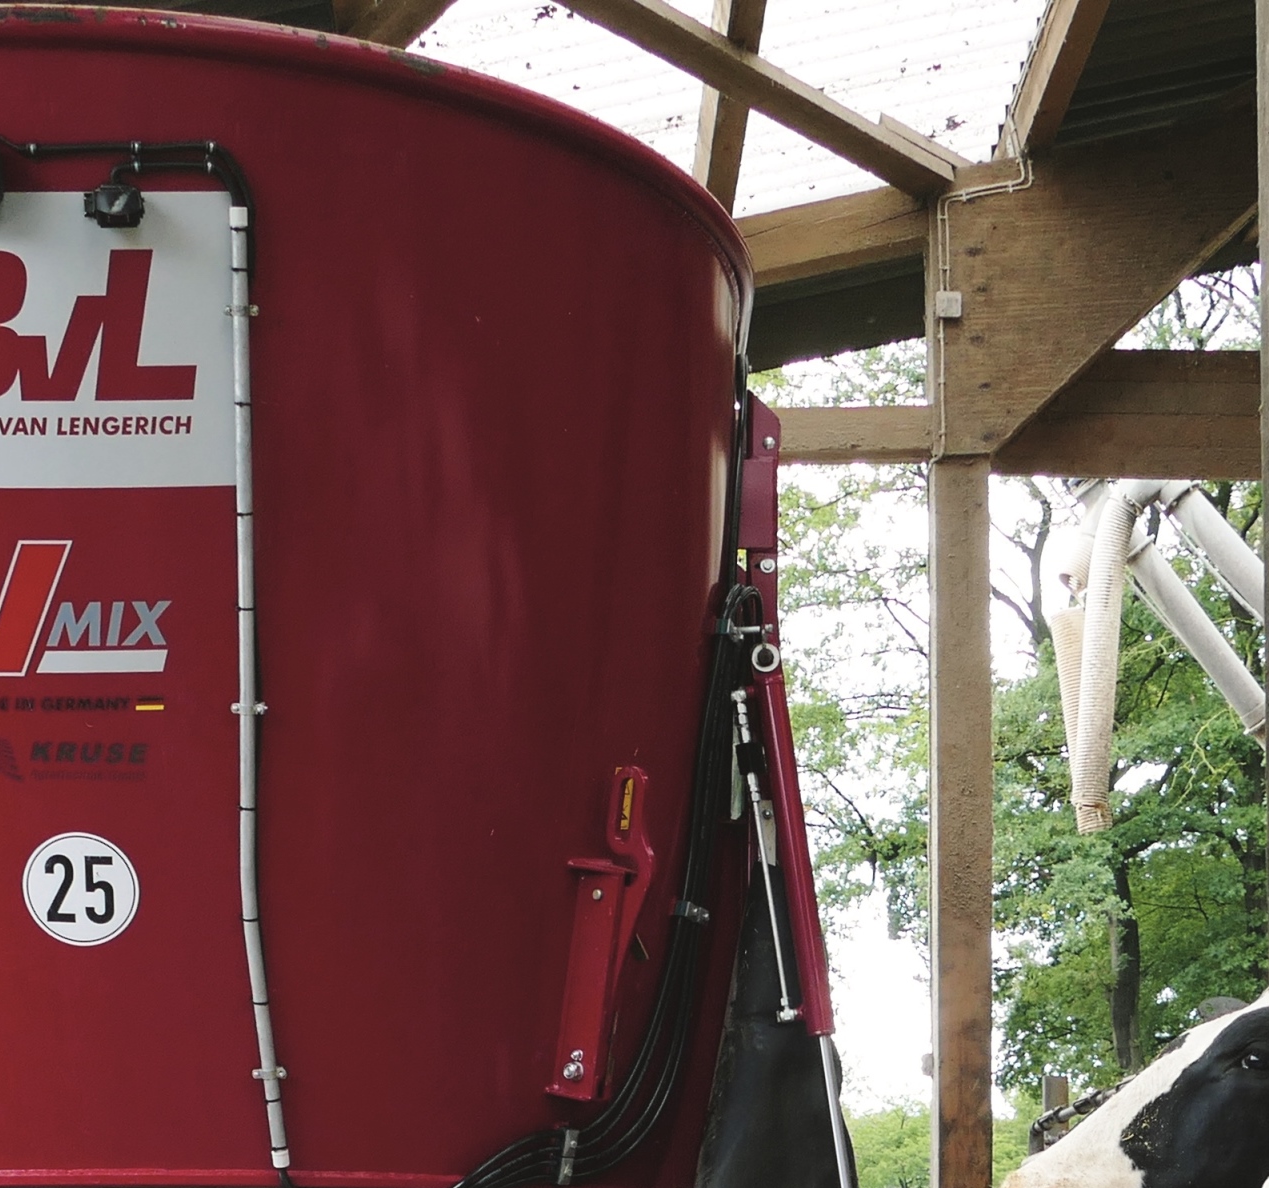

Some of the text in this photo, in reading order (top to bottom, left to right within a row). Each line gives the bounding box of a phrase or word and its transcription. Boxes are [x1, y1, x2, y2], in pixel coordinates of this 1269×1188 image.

[56, 415, 192, 436] LENGERICH
[14, 696, 36, 711] IN
[40, 696, 131, 711] GERMANY
[29, 740, 150, 765] KRUSE
[44, 853, 115, 925] 25
